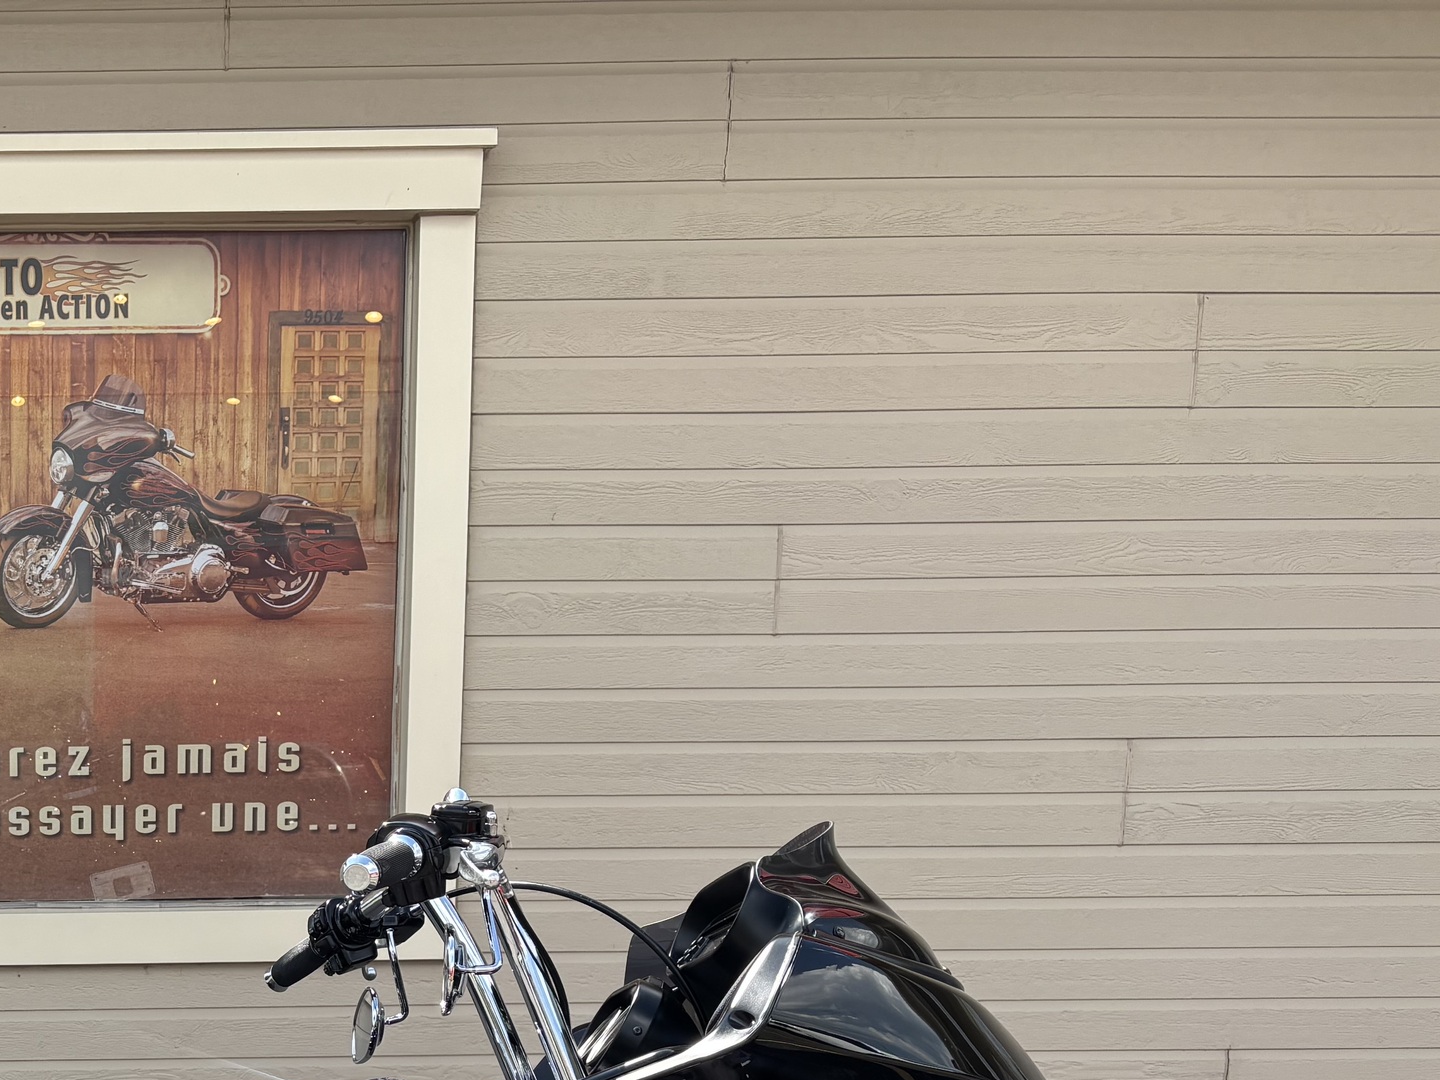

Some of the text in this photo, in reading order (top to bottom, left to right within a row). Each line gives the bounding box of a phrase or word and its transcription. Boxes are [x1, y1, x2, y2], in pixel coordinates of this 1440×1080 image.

[1, 293, 130, 320] en ACTION
[303, 309, 344, 324] 9504
[122, 735, 300, 782] jamais
[211, 801, 356, 834] une...
